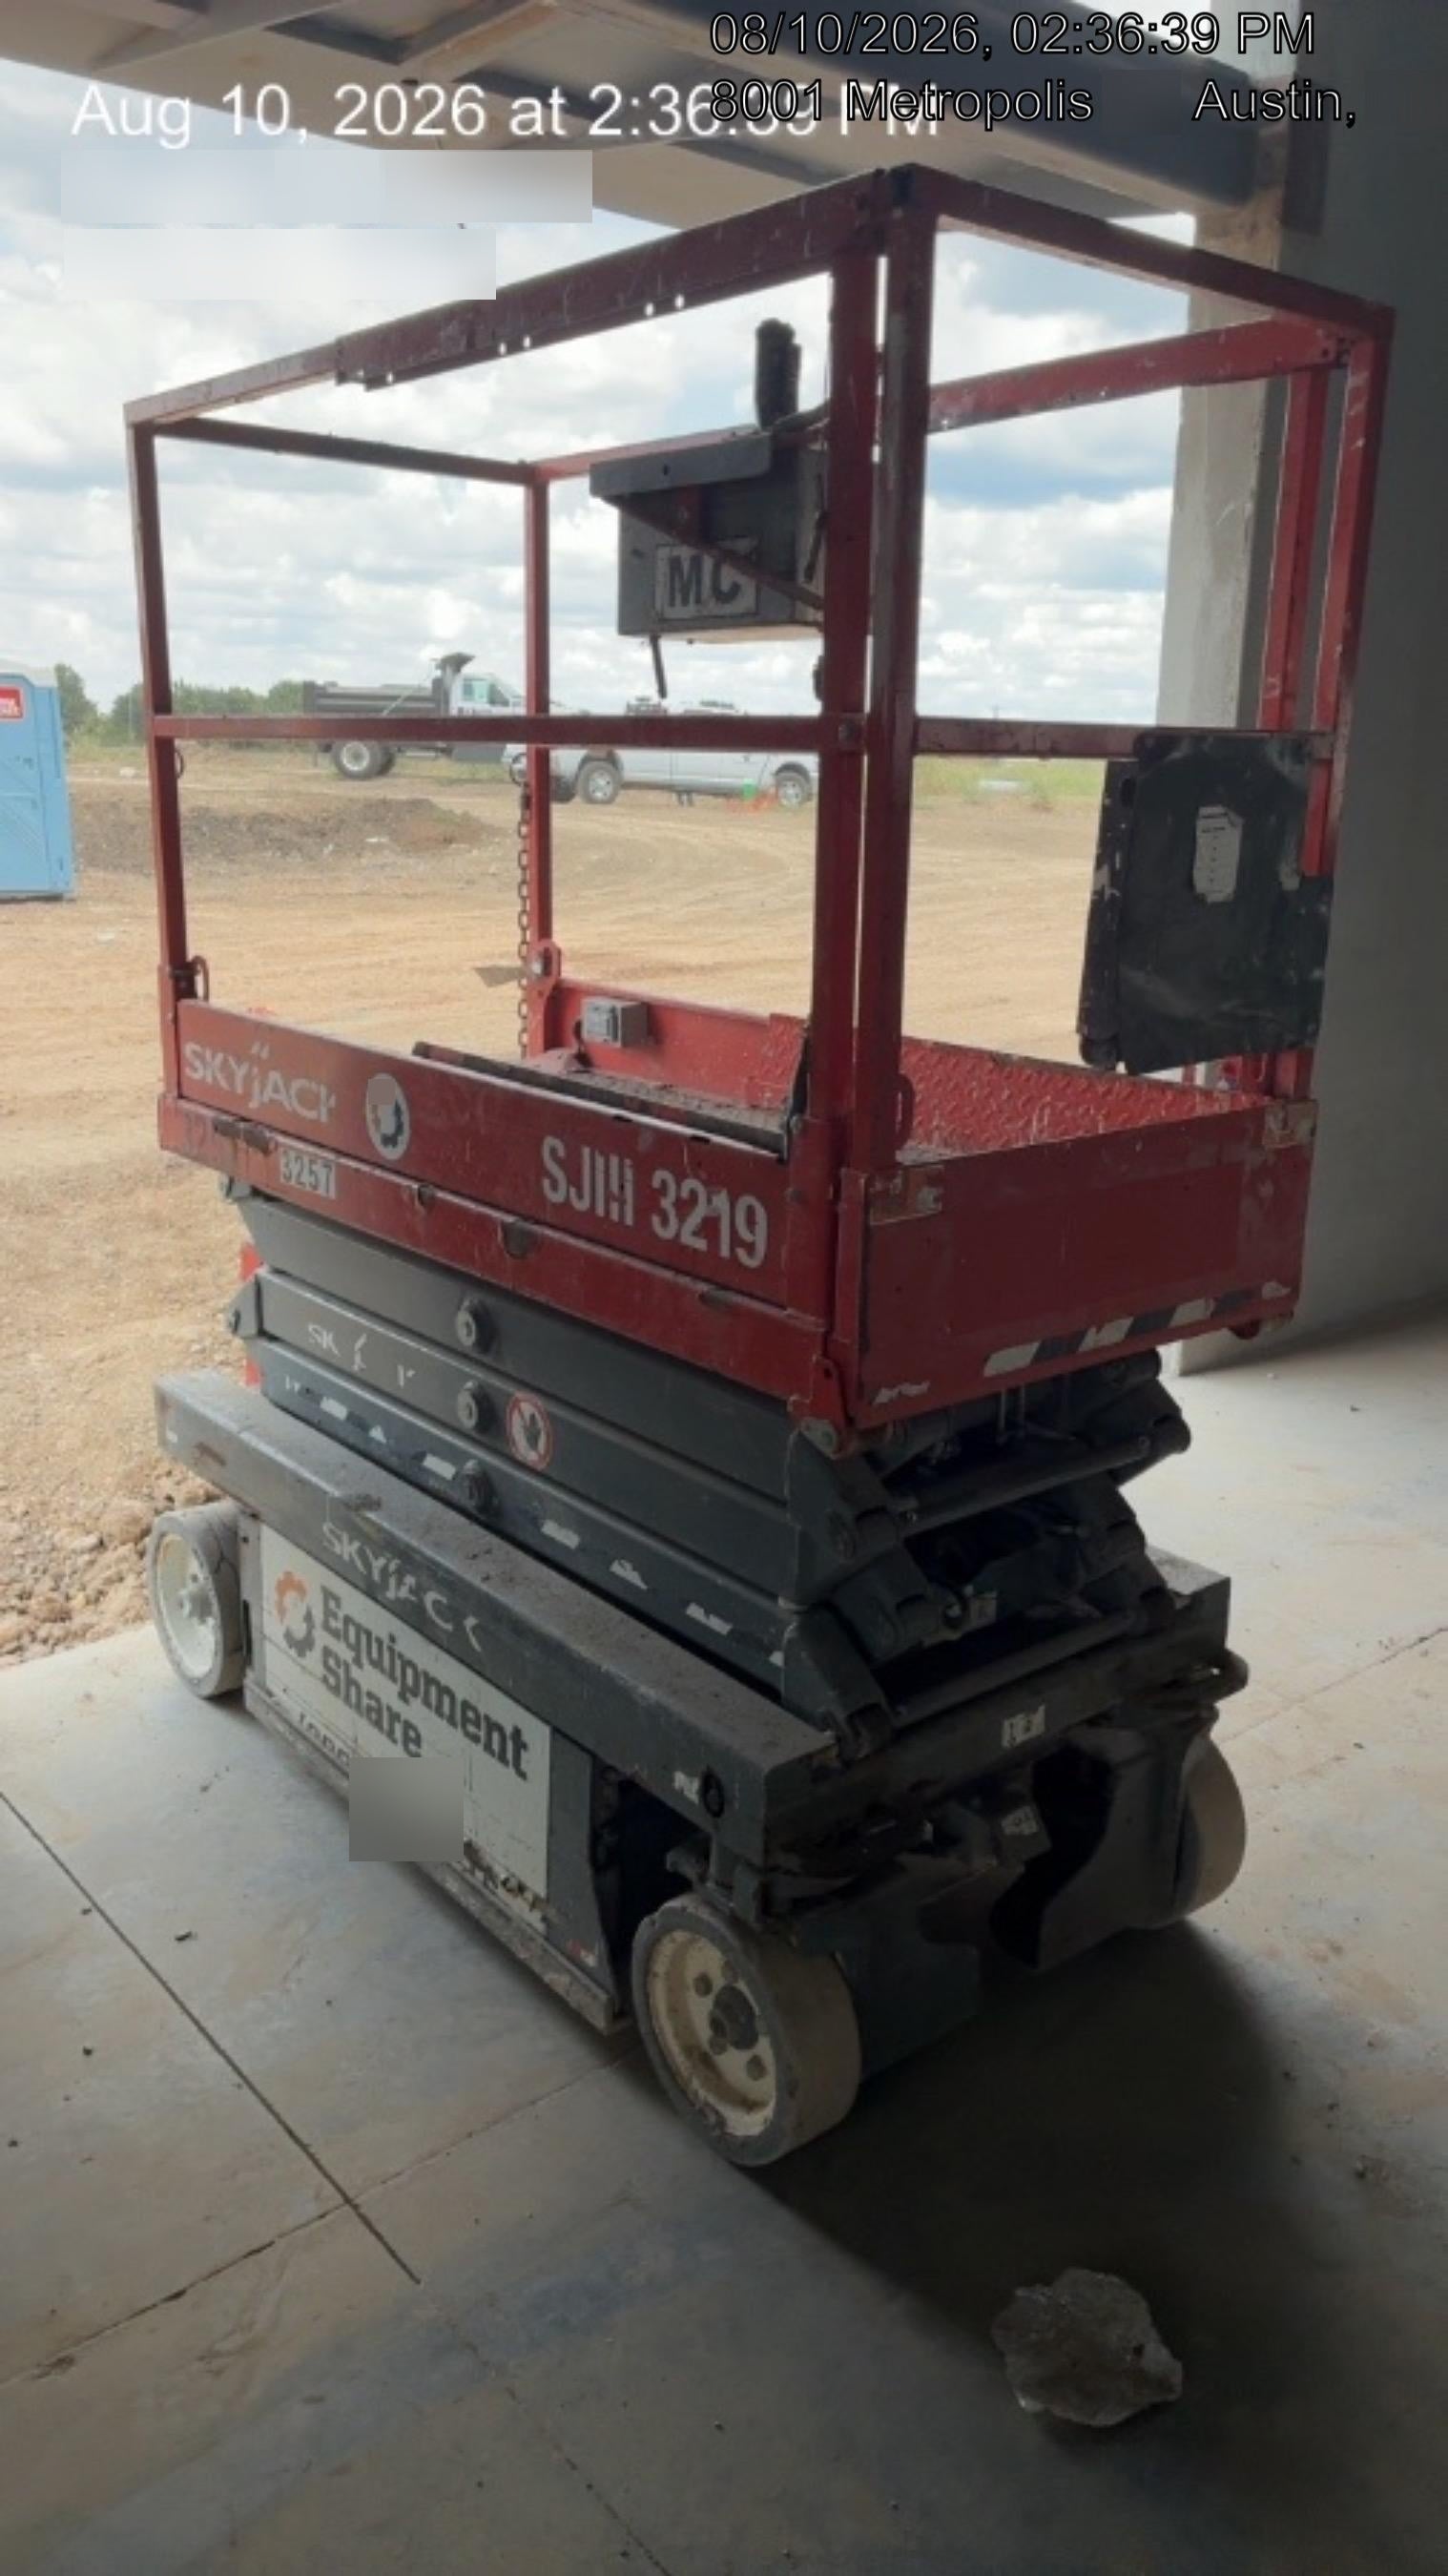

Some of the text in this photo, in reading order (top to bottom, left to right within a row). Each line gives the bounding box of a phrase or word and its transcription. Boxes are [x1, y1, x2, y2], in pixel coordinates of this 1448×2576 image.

[281, 1148, 334, 1196] 3257
[650, 1168, 768, 1270] 3219
[321, 1584, 529, 1781] Equipment
[321, 1644, 423, 1758] Share
